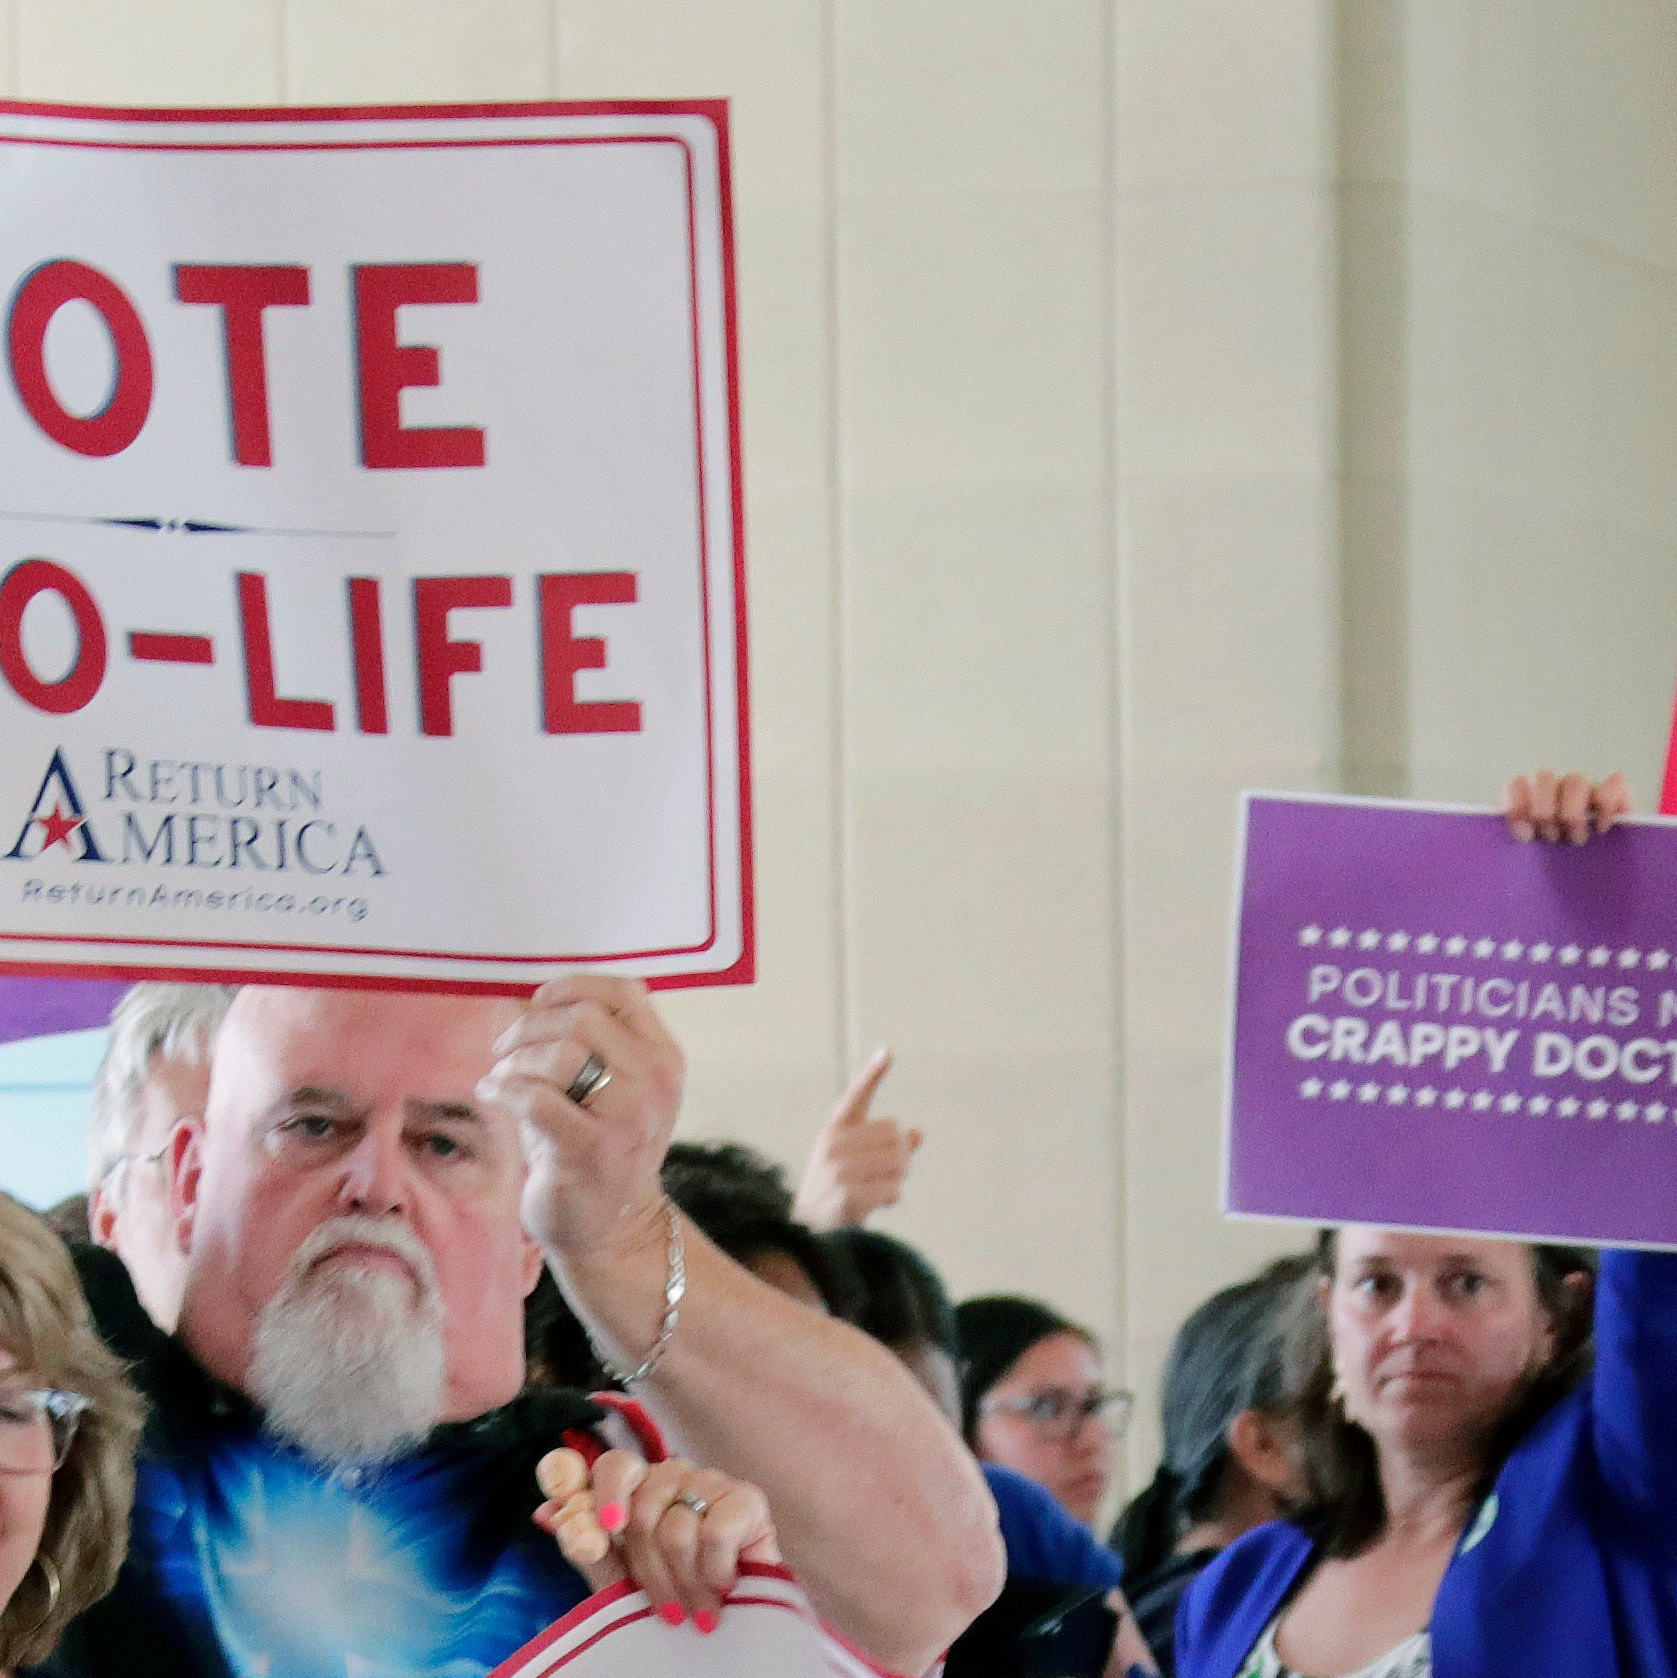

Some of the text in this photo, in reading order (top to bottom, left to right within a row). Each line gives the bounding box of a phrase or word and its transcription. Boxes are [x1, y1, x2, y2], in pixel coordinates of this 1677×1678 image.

[102, 747, 322, 810] RETURN
[22, 876, 370, 923] ReturnAmerica.org
[1308, 963, 1641, 1027] POLITICIANS
[1287, 1012, 1520, 1074] CRAPPY
